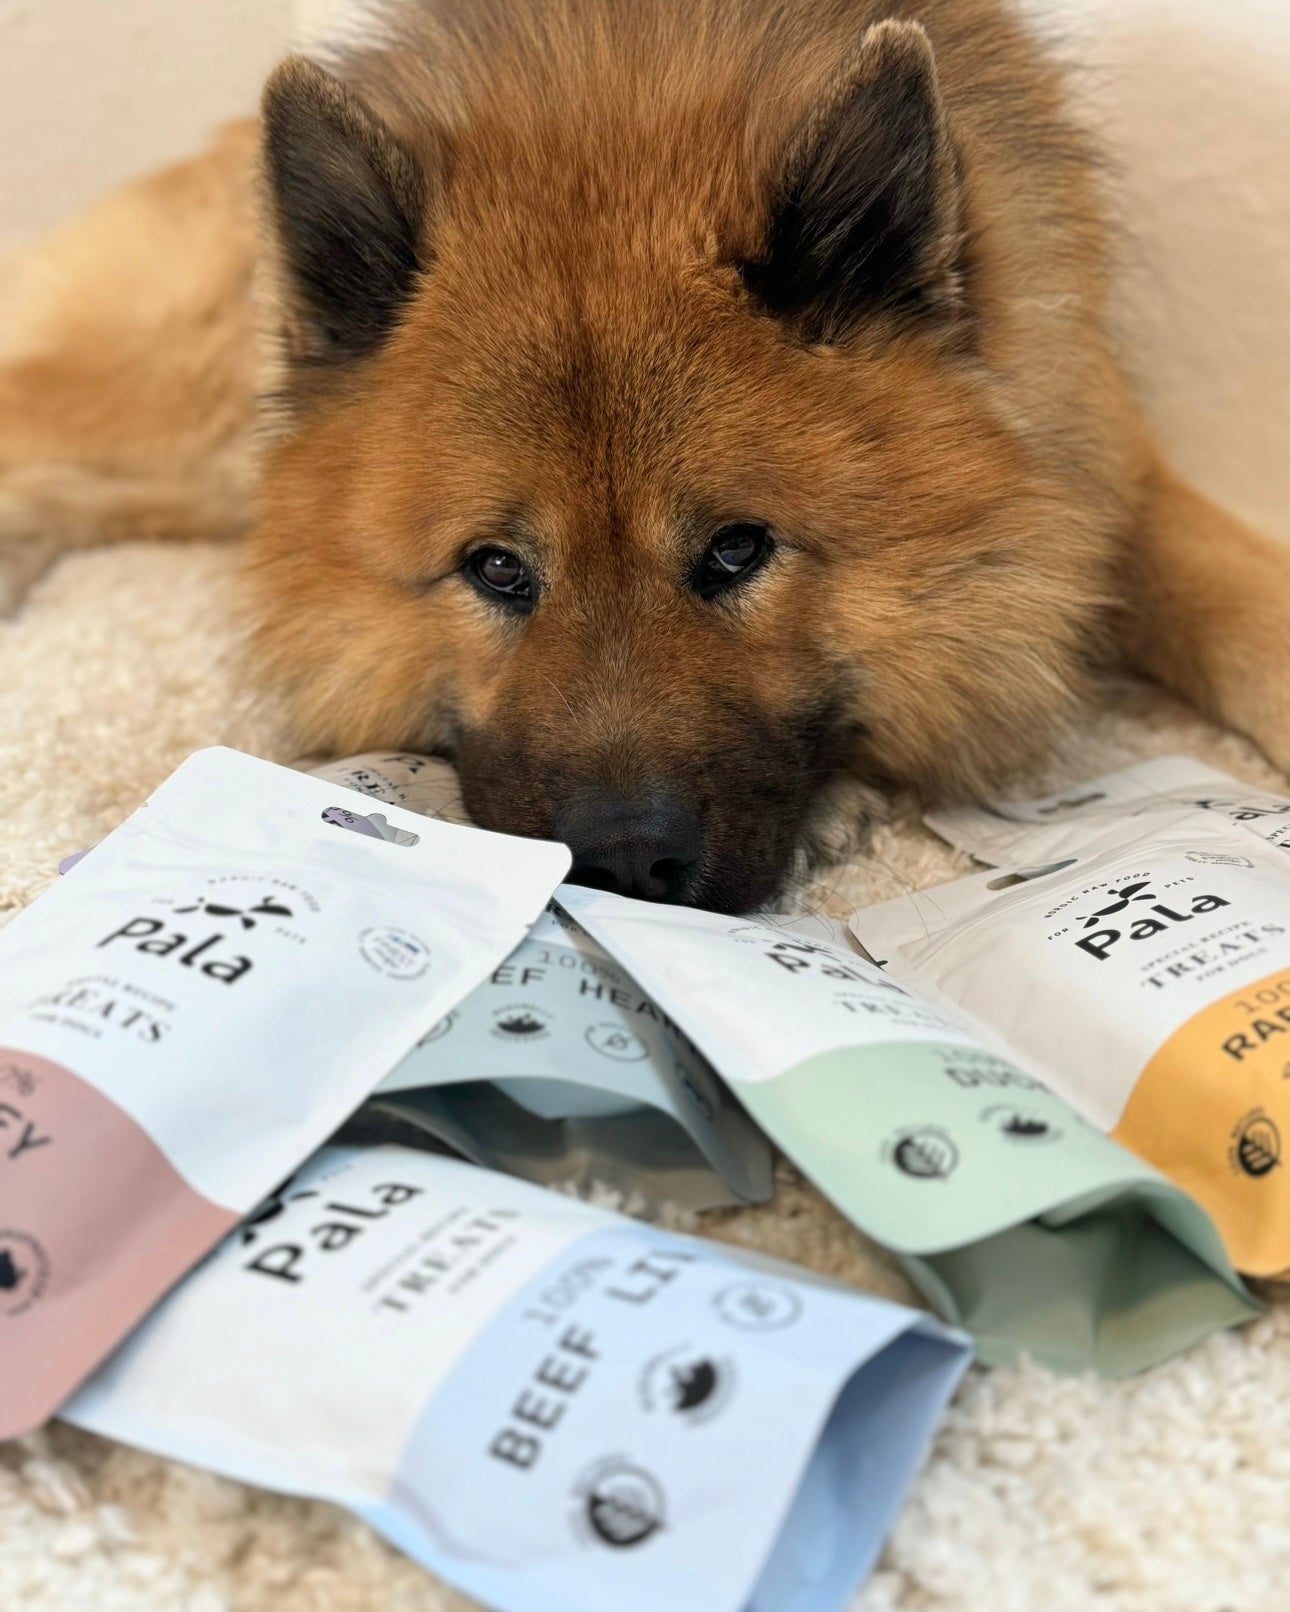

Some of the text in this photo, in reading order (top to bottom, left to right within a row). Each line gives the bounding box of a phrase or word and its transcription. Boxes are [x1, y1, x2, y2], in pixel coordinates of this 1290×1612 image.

[1047, 876, 1196, 941] FOR PETS
[1082, 882, 1108, 894] RAW
[1116, 872, 1151, 883] FOOD
[1140, 922, 1287, 990] TREATS
[486, 1322, 601, 1473] BEEF
